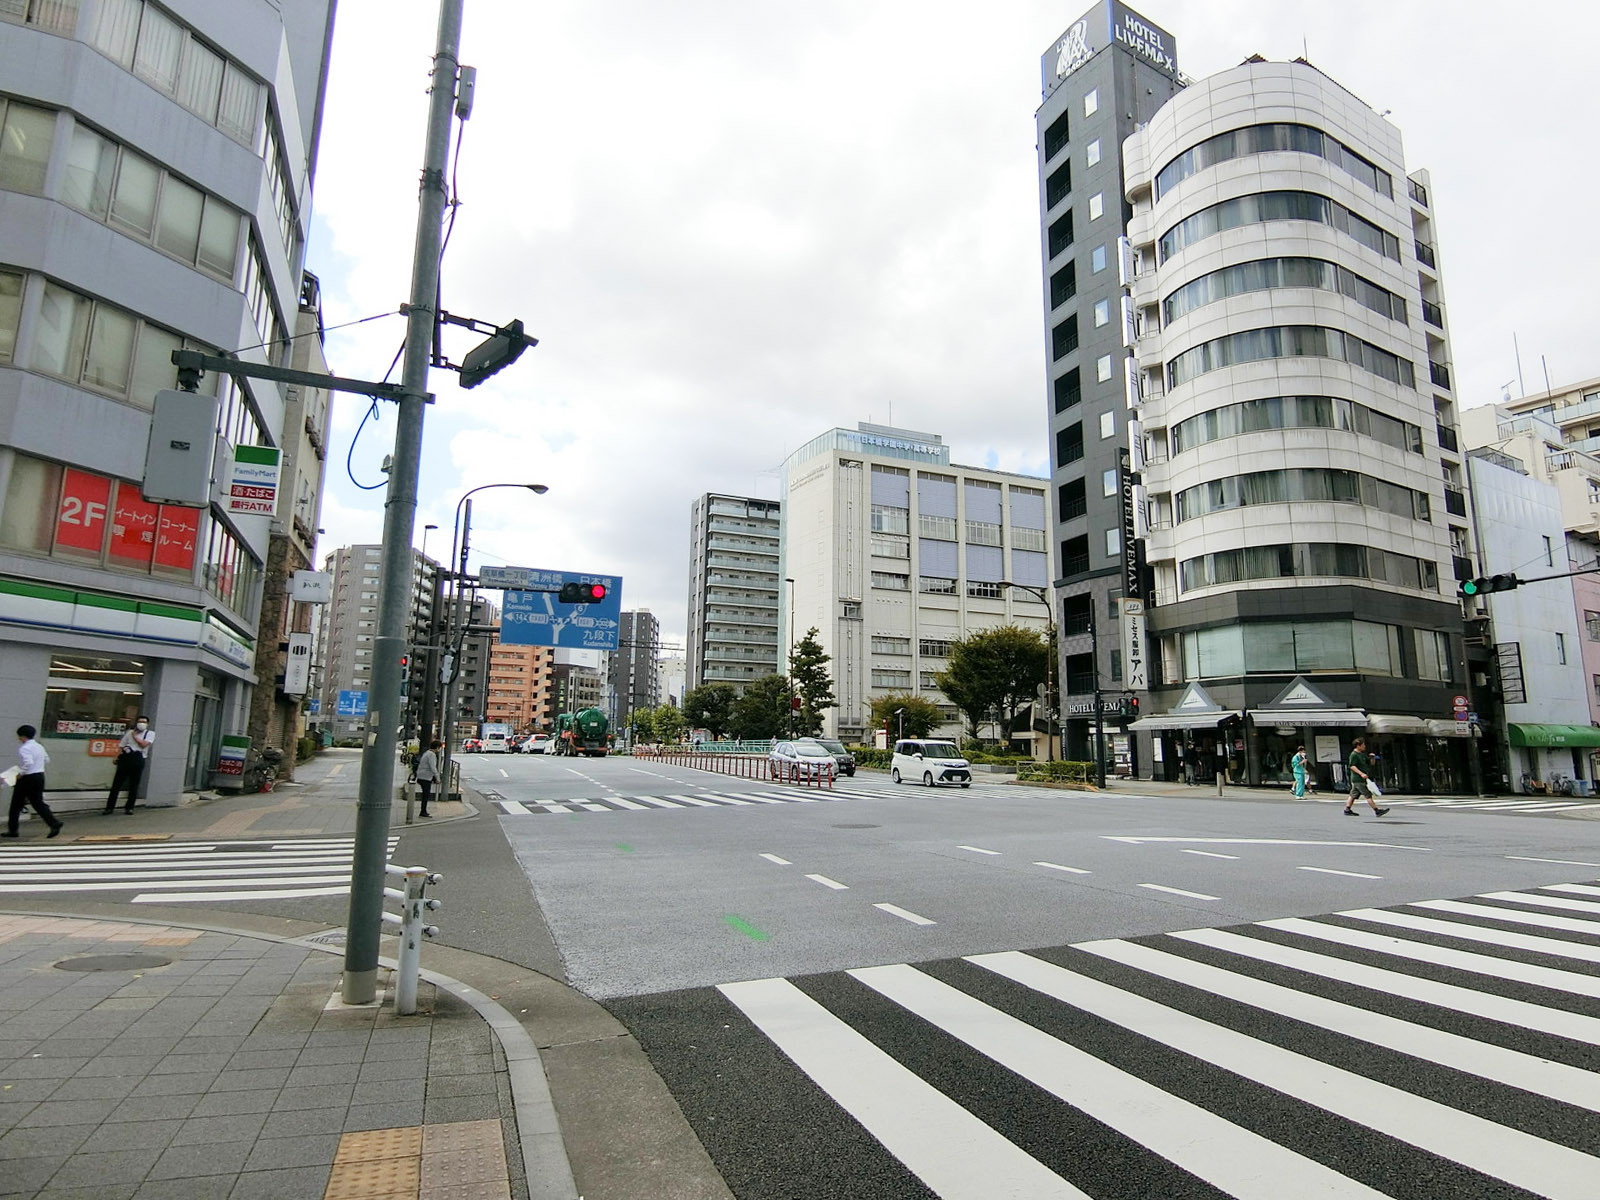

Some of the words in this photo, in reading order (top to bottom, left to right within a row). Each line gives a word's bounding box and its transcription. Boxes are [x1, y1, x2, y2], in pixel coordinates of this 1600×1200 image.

[1125, 14, 1164, 50] HOTEL
[234, 467, 276, 478] FamilyMart
[61, 496, 106, 527] 2F
[582, 630, 616, 641] 九段下
[1069, 704, 1090, 713] HOTEL
